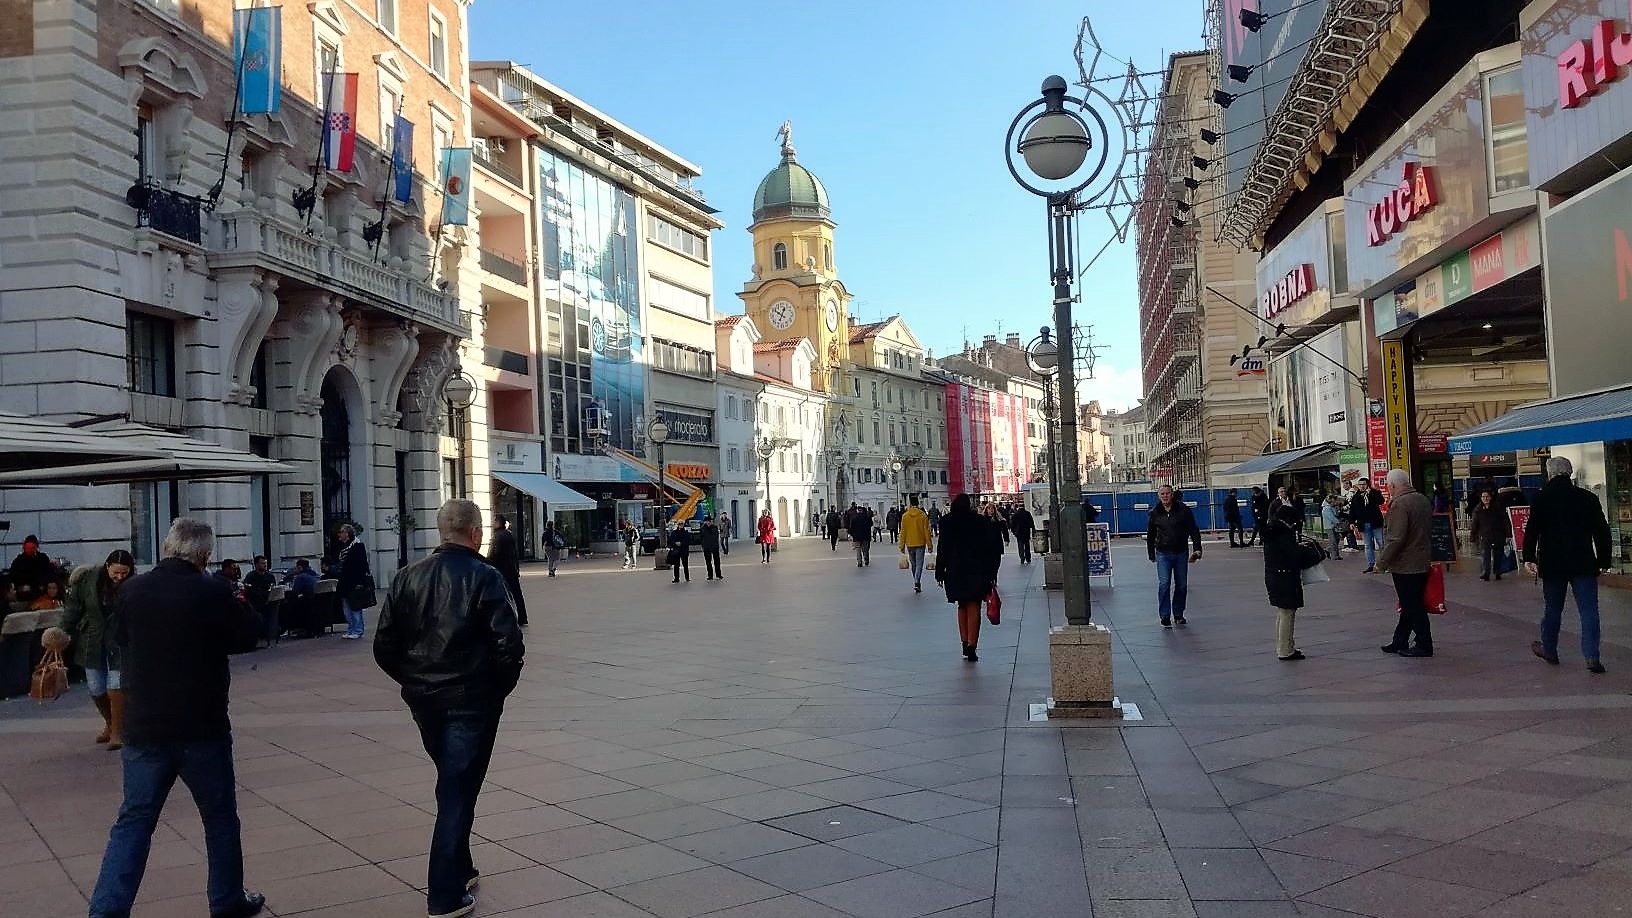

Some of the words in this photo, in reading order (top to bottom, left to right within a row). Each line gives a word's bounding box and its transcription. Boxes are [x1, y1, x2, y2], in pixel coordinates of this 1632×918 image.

[1263, 264, 1311, 319] ROBNA
[1241, 357, 1263, 370] dm
[1390, 347, 1399, 406] HAPPY
[1394, 413, 1403, 460] HOME
